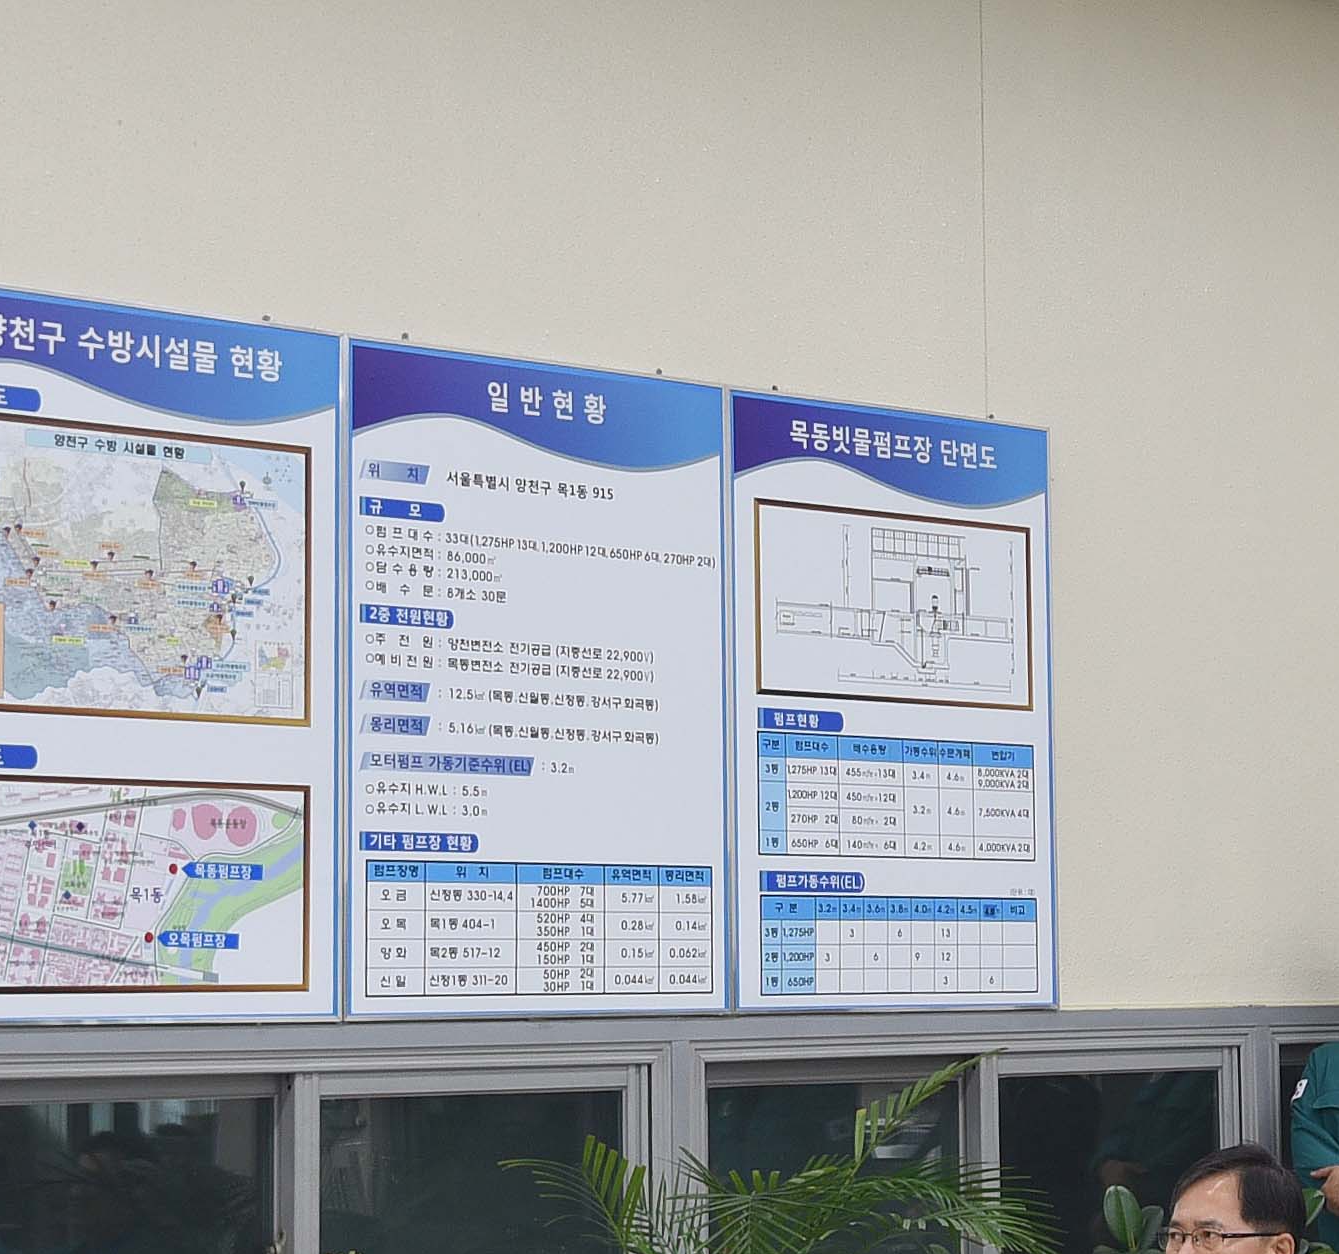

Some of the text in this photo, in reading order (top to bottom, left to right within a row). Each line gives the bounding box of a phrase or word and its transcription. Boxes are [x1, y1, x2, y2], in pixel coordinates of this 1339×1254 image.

[78, 326, 218, 373] 수방시설물
[230, 345, 283, 382] 현황
[487, 381, 607, 425] 일반현황
[54, 433, 184, 460] 양천구 수방 시설물 현황
[790, 420, 997, 469] 목동빗물펌프장 단면도
[447, 472, 509, 491] 서울특별시
[515, 478, 552, 496] 양천구
[558, 483, 588, 499] 목1동
[593, 488, 614, 499] 915
[664, 553, 694, 565] 270HP
[447, 588, 476, 601] 8개소
[482, 591, 506, 603] 30문
[370, 607, 448, 626] 2중 전원현황
[448, 638, 503, 652] 양천변전소
[510, 642, 551, 657] 전기공급
[448, 658, 503, 672] 목동변전소
[510, 662, 551, 676] 전기공급
[370, 682, 423, 699] 유역면적
[370, 717, 423, 733] 몽리면적
[774, 712, 818, 728] 펌프현황
[763, 739, 780, 749] 구분
[370, 754, 423, 769] 모터펌프
[376, 782, 410, 795] 유수지
[376, 802, 410, 815] 유수지
[370, 834, 472, 850] 기타 펌프장 현황
[194, 864, 252, 879] 목동펌프장
[543, 868, 584, 880] 펌프대수
[612, 869, 652, 881] 유역면적
[776, 874, 863, 889] 펌프가동수위(EL)
[131, 887, 163, 903] 목1동
[537, 886, 594, 896] 700HP 7대
[531, 898, 594, 908] 1400HP 5대
[462, 919, 495, 929] 404-1
[537, 913, 594, 923] 520HP 4대
[537, 927, 594, 936] 350HP 1대
[850, 928, 854, 937] 3
[898, 928, 902, 937] 6
[942, 928, 950, 937] 13
[167, 933, 225, 947] 오목펌프장
[463, 948, 500, 958] 517-12
[537, 942, 594, 952] 450HP 2대
[537, 954, 594, 964] 150HP 1대
[825, 953, 830, 962] 3
[874, 952, 878, 961] 6
[915, 952, 920, 960] 9
[942, 952, 950, 961] 12
[472, 975, 508, 986] 311-20
[543, 969, 594, 979] 50HP 2대
[943, 976, 948, 985] 3
[989, 976, 994, 984] 6
[543, 981, 594, 992] 30HP 1대
